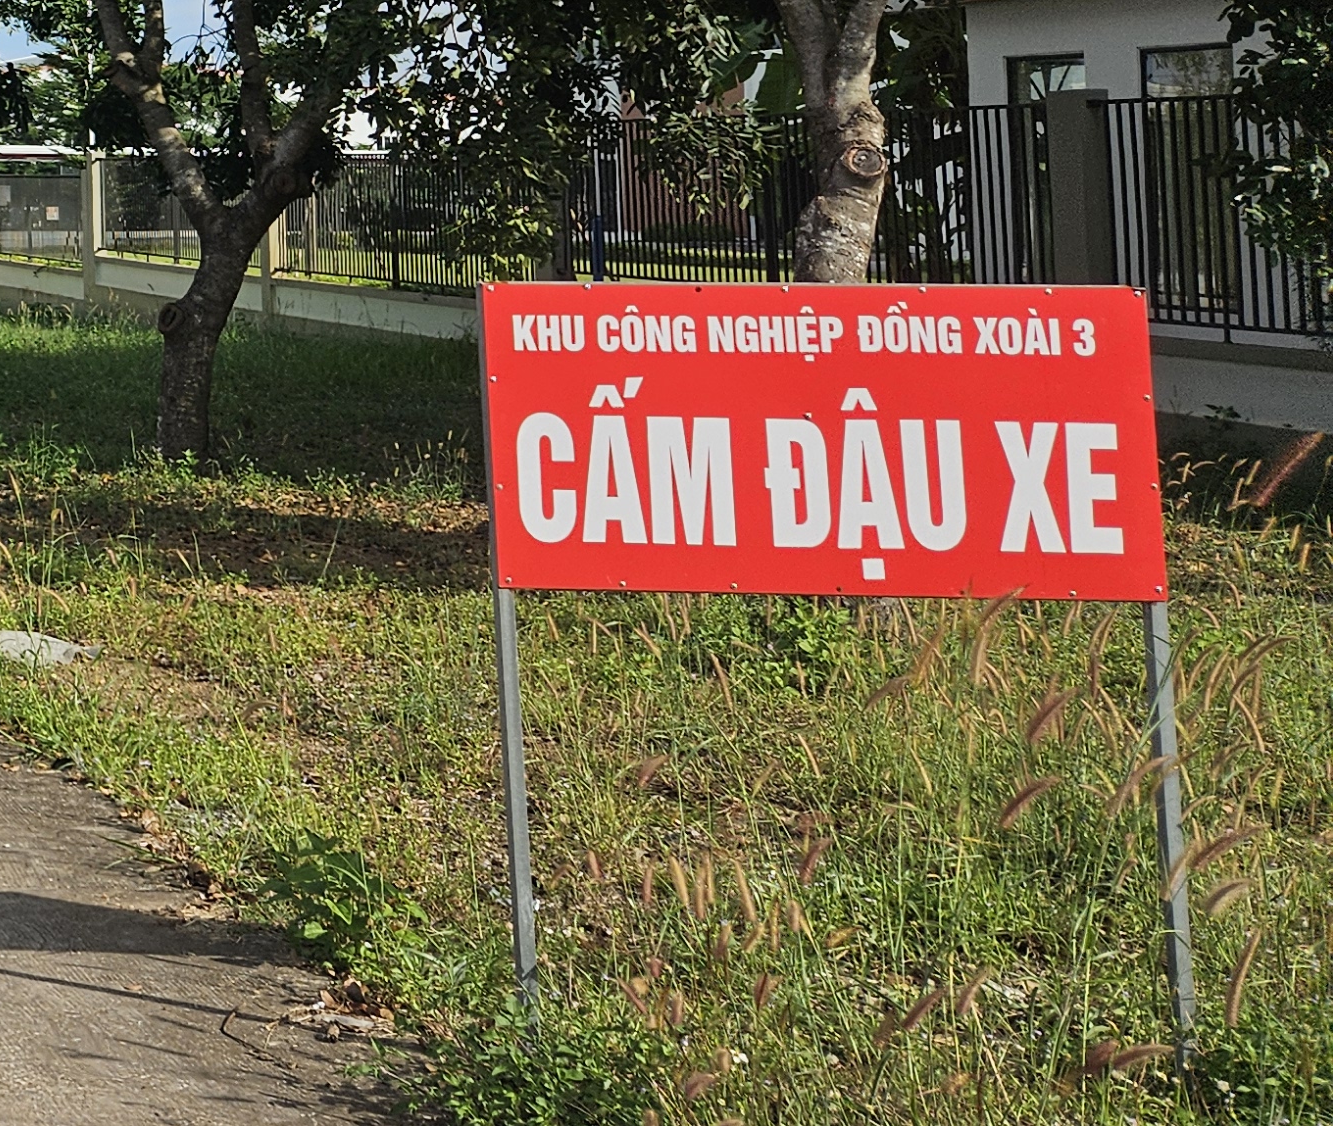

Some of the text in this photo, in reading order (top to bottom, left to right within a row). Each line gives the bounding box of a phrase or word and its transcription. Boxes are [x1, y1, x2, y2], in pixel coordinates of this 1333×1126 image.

[511, 301, 1096, 362] KHU CÔNG NGHIỆP ĐỒNG XOÀI 3
[516, 376, 1125, 581] CẤM ĐẬU XE
